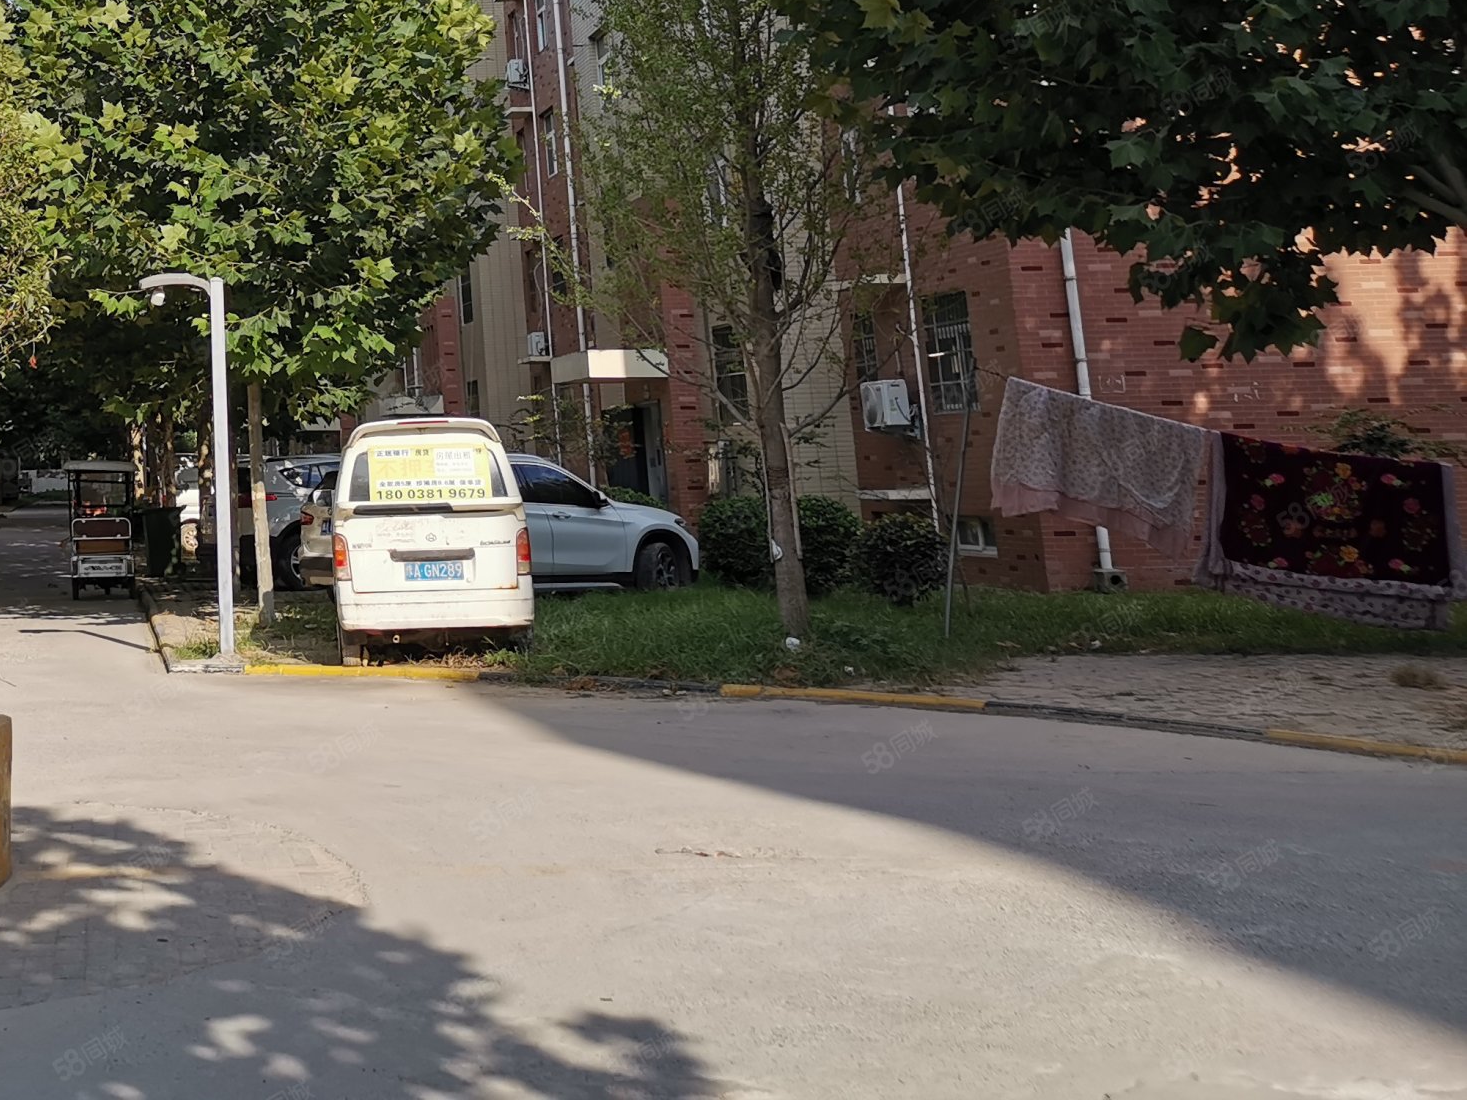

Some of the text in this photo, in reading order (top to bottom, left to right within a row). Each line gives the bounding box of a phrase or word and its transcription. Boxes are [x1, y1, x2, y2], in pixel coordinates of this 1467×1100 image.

[376, 488, 485, 500] 180 0381 9679
